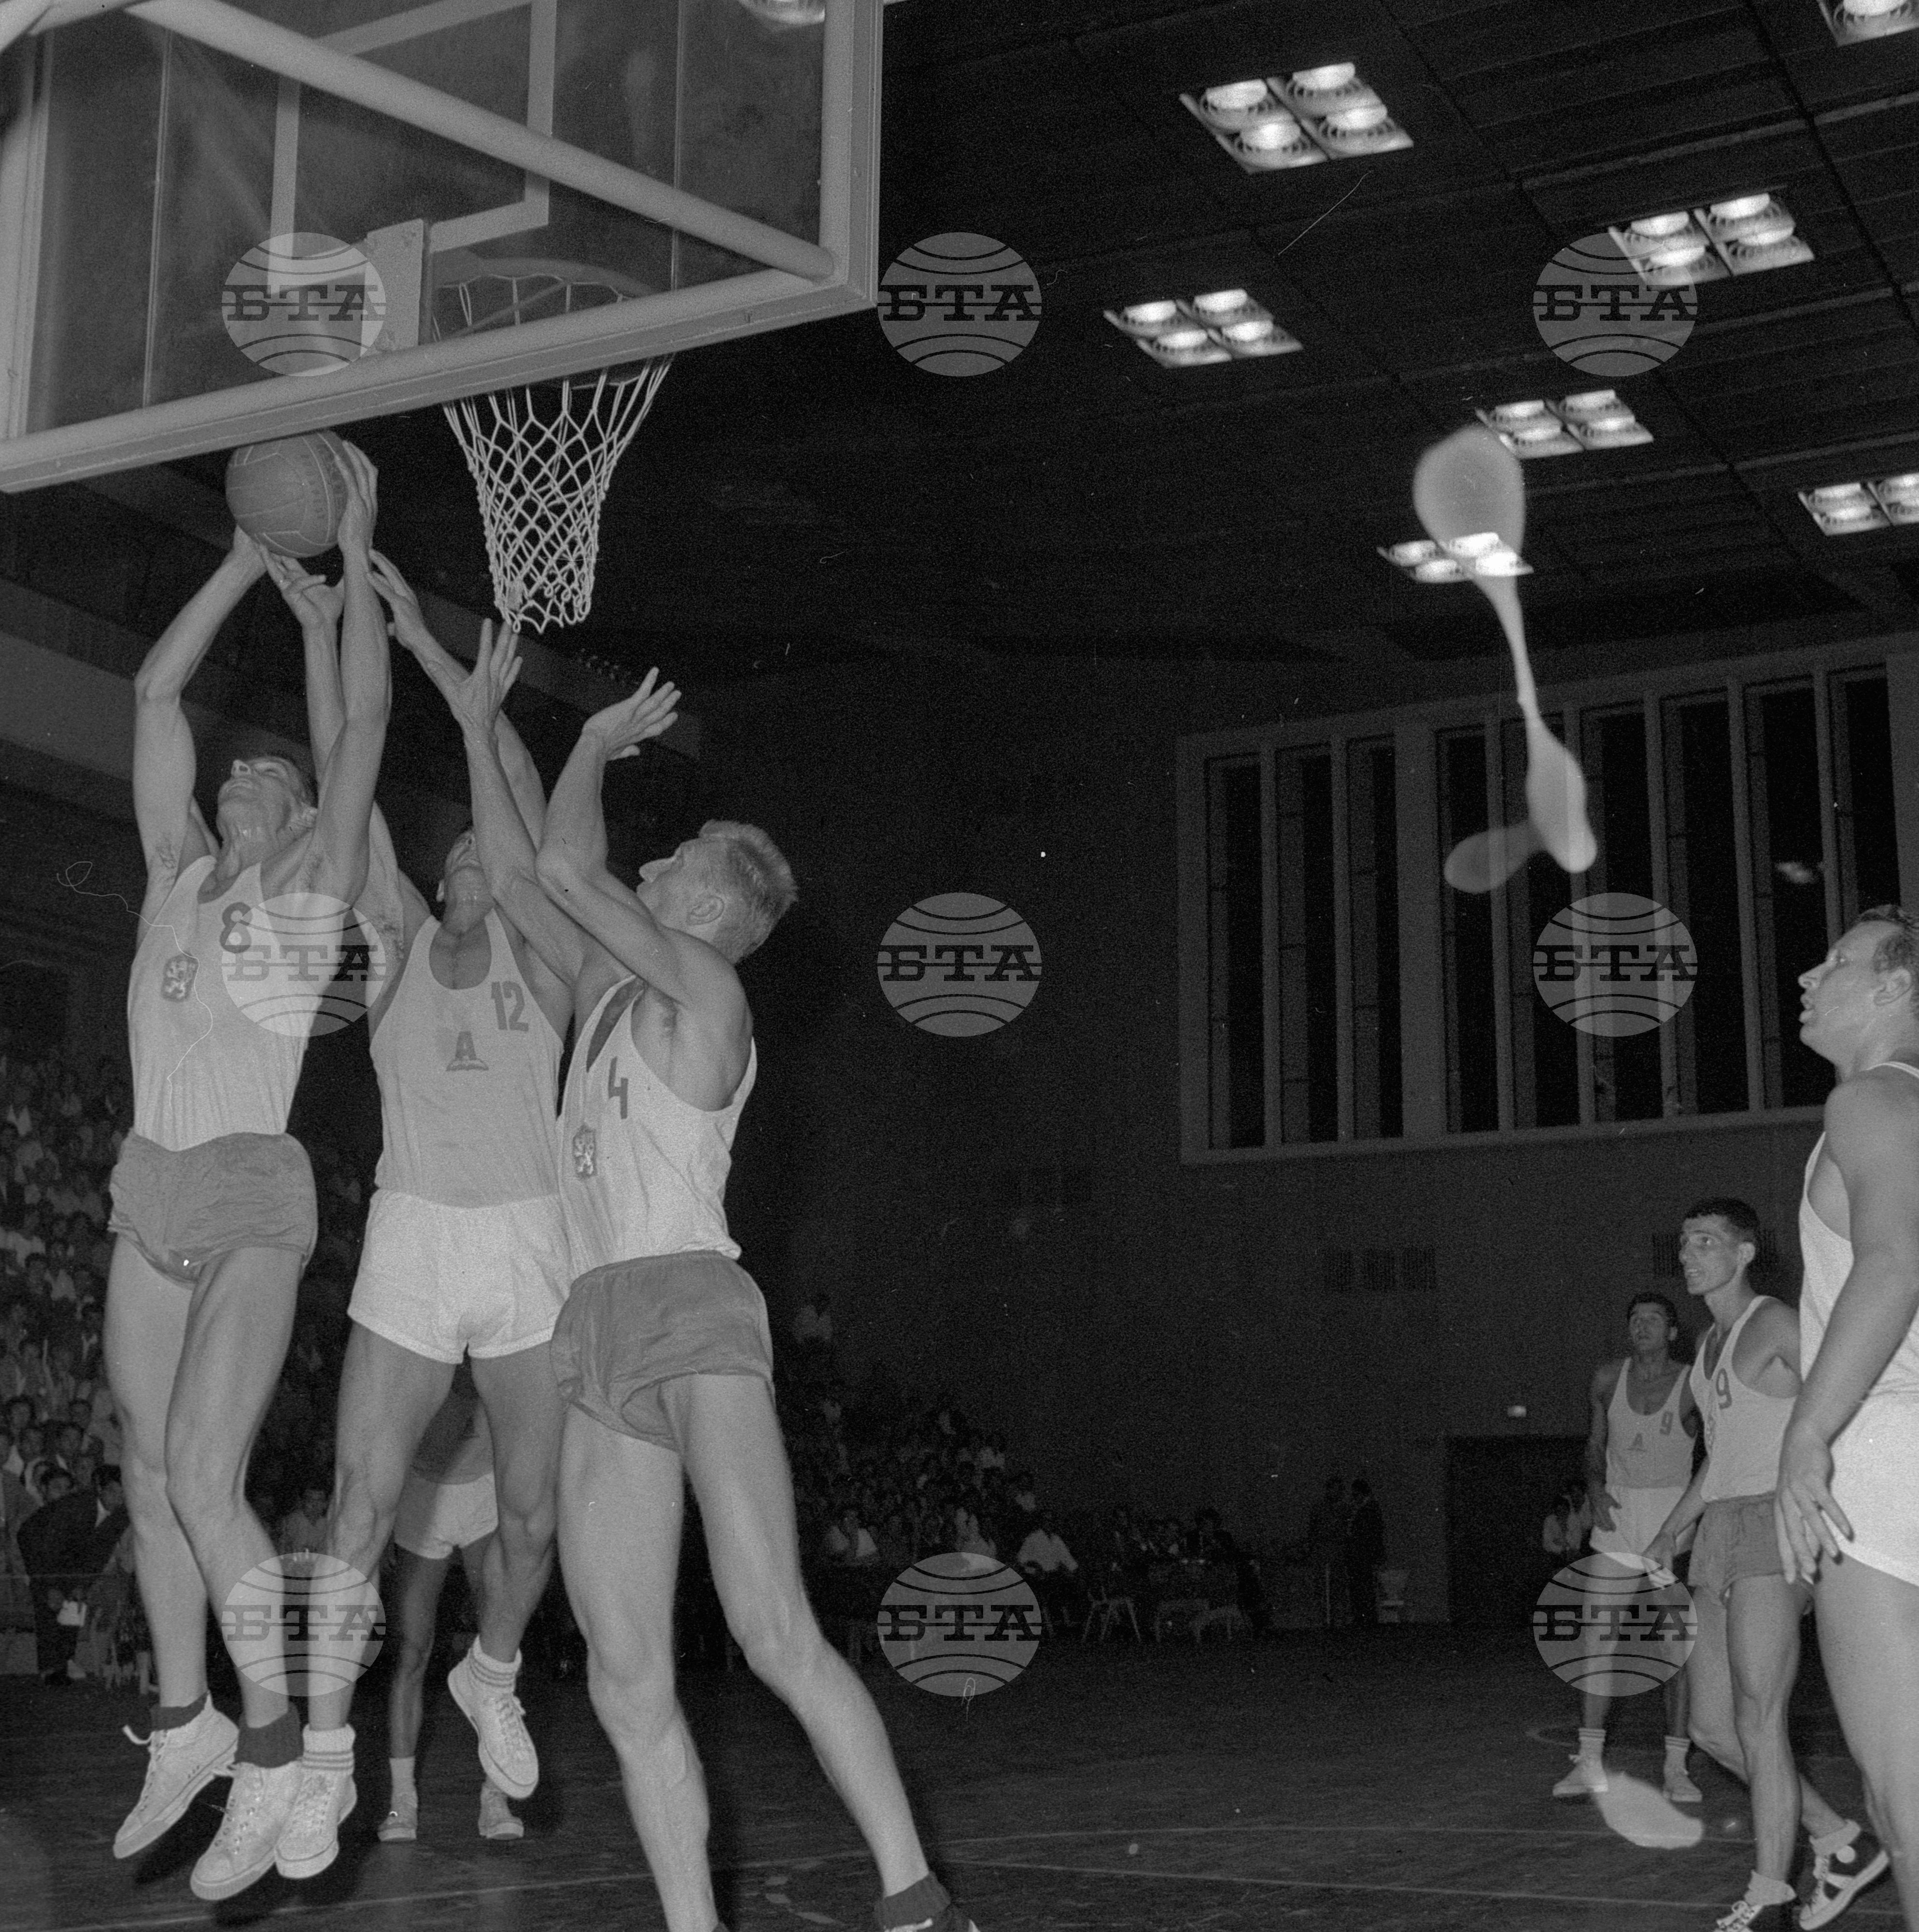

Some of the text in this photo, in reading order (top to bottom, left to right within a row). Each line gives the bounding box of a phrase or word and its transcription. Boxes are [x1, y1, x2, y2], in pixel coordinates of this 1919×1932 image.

[220, 902, 253, 953] 8
[491, 980, 529, 1032] 12
[608, 1056, 628, 1120] 4
[1716, 1368, 1733, 1410] 9
